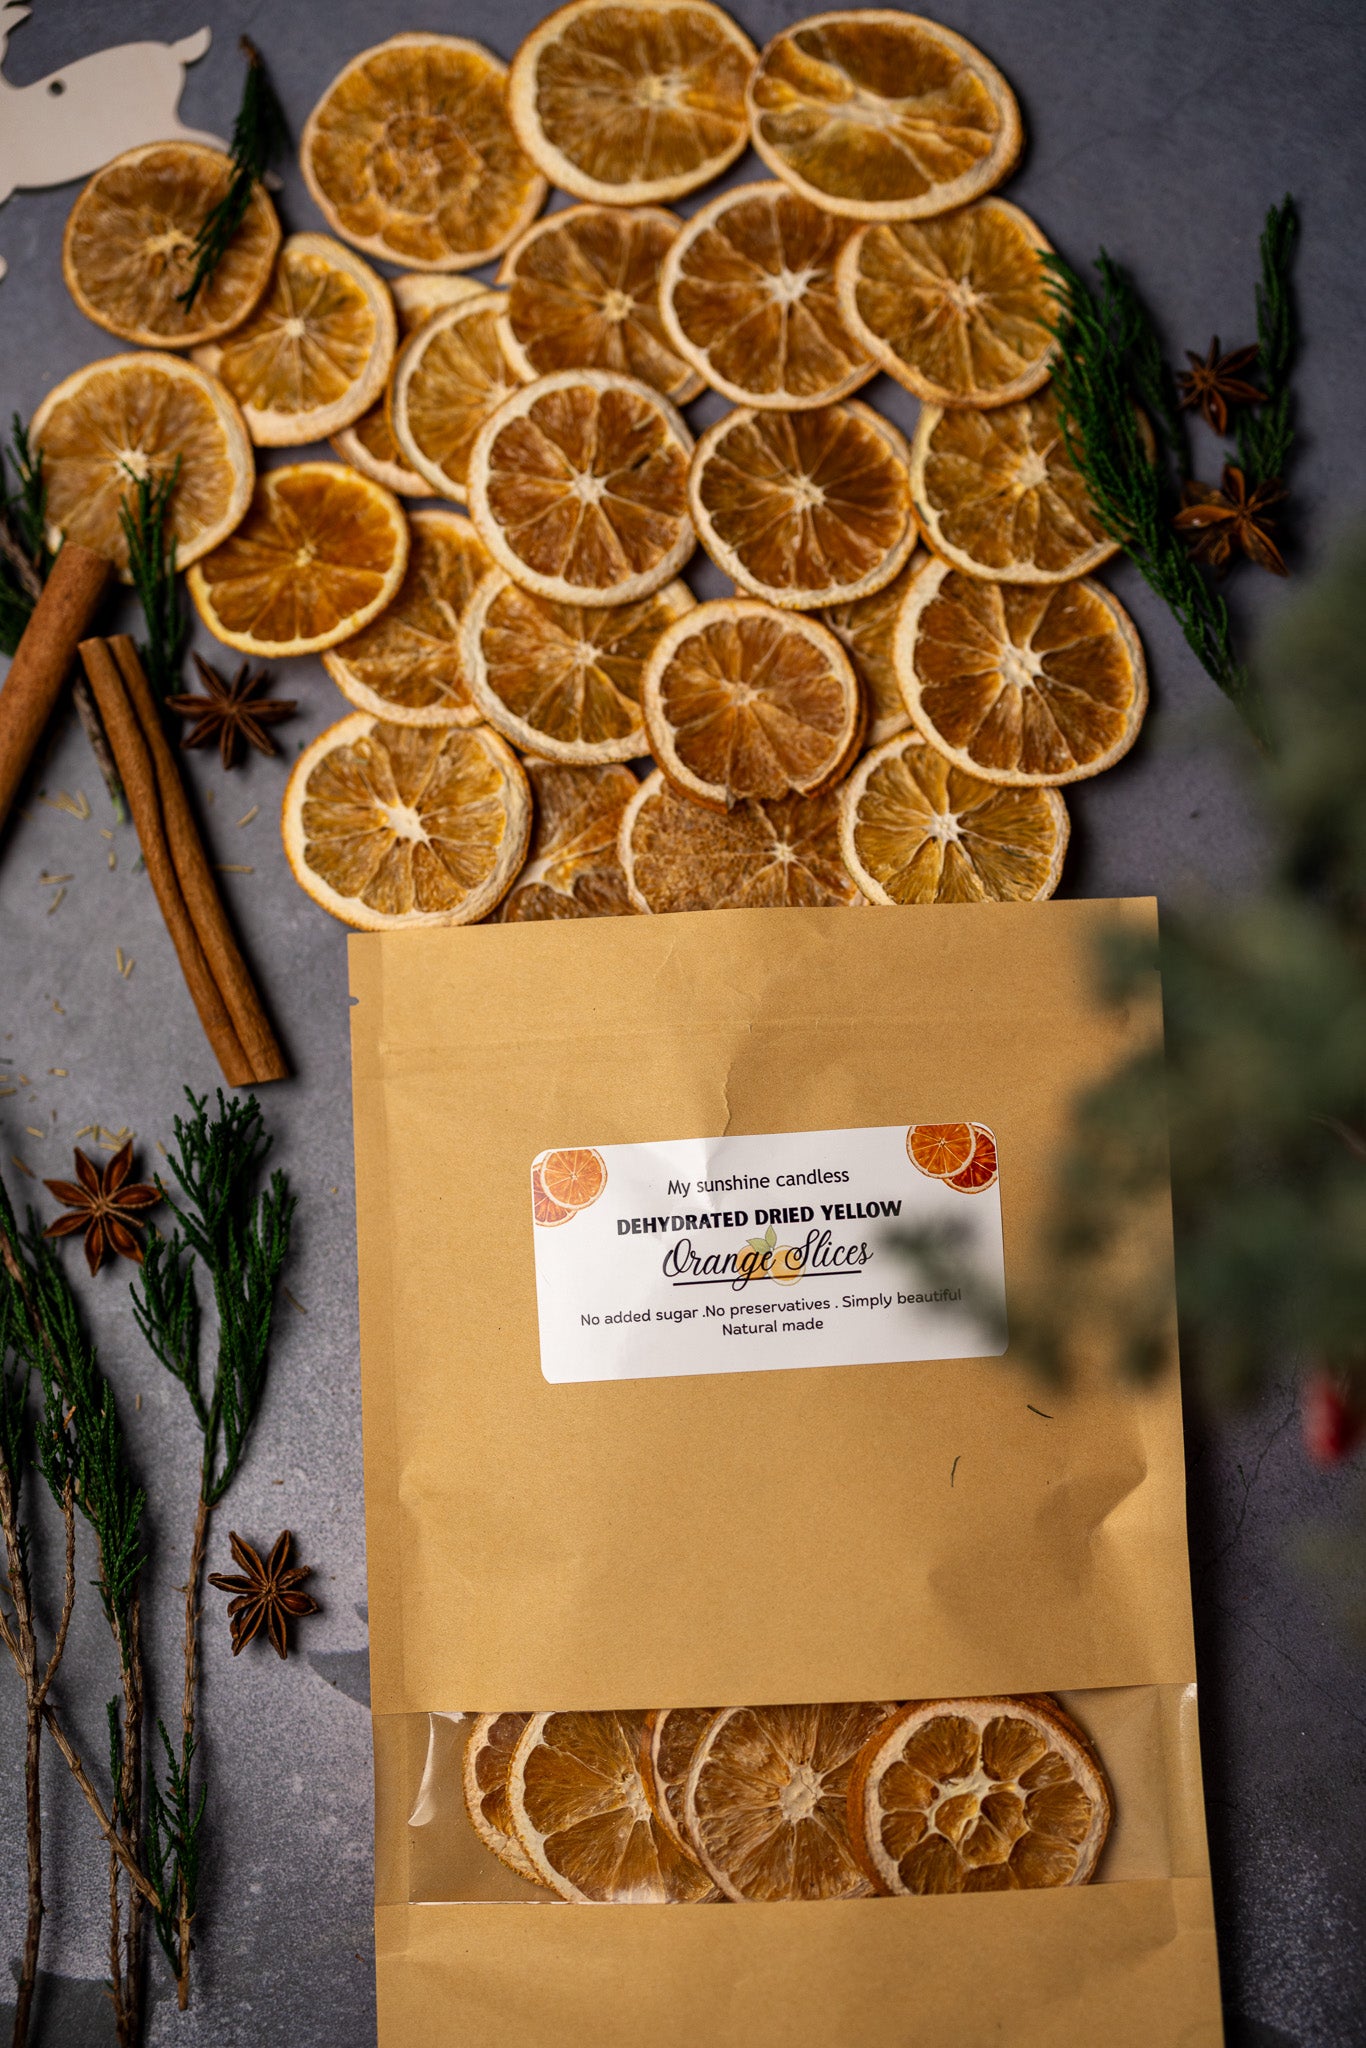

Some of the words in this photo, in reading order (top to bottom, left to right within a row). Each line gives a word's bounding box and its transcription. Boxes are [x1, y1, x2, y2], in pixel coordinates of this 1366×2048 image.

[667, 1179, 691, 1198] My
[696, 1175, 771, 1193] sunshine
[776, 1169, 850, 1187] candless
[616, 1210, 749, 1235] DEHYDRATED
[754, 1206, 815, 1225] DRIED
[820, 1200, 902, 1221] YELLOW
[662, 1238, 776, 1291] Orange
[784, 1228, 874, 1270] Slices
[581, 1314, 600, 1326] No
[604, 1309, 651, 1325] added
[655, 1307, 698, 1323] sugar
[730, 1297, 830, 1320] preservatives
[842, 1292, 892, 1309] Simply
[897, 1288, 962, 1305] beautiful
[722, 1320, 778, 1336] Natural
[782, 1317, 824, 1332] made
